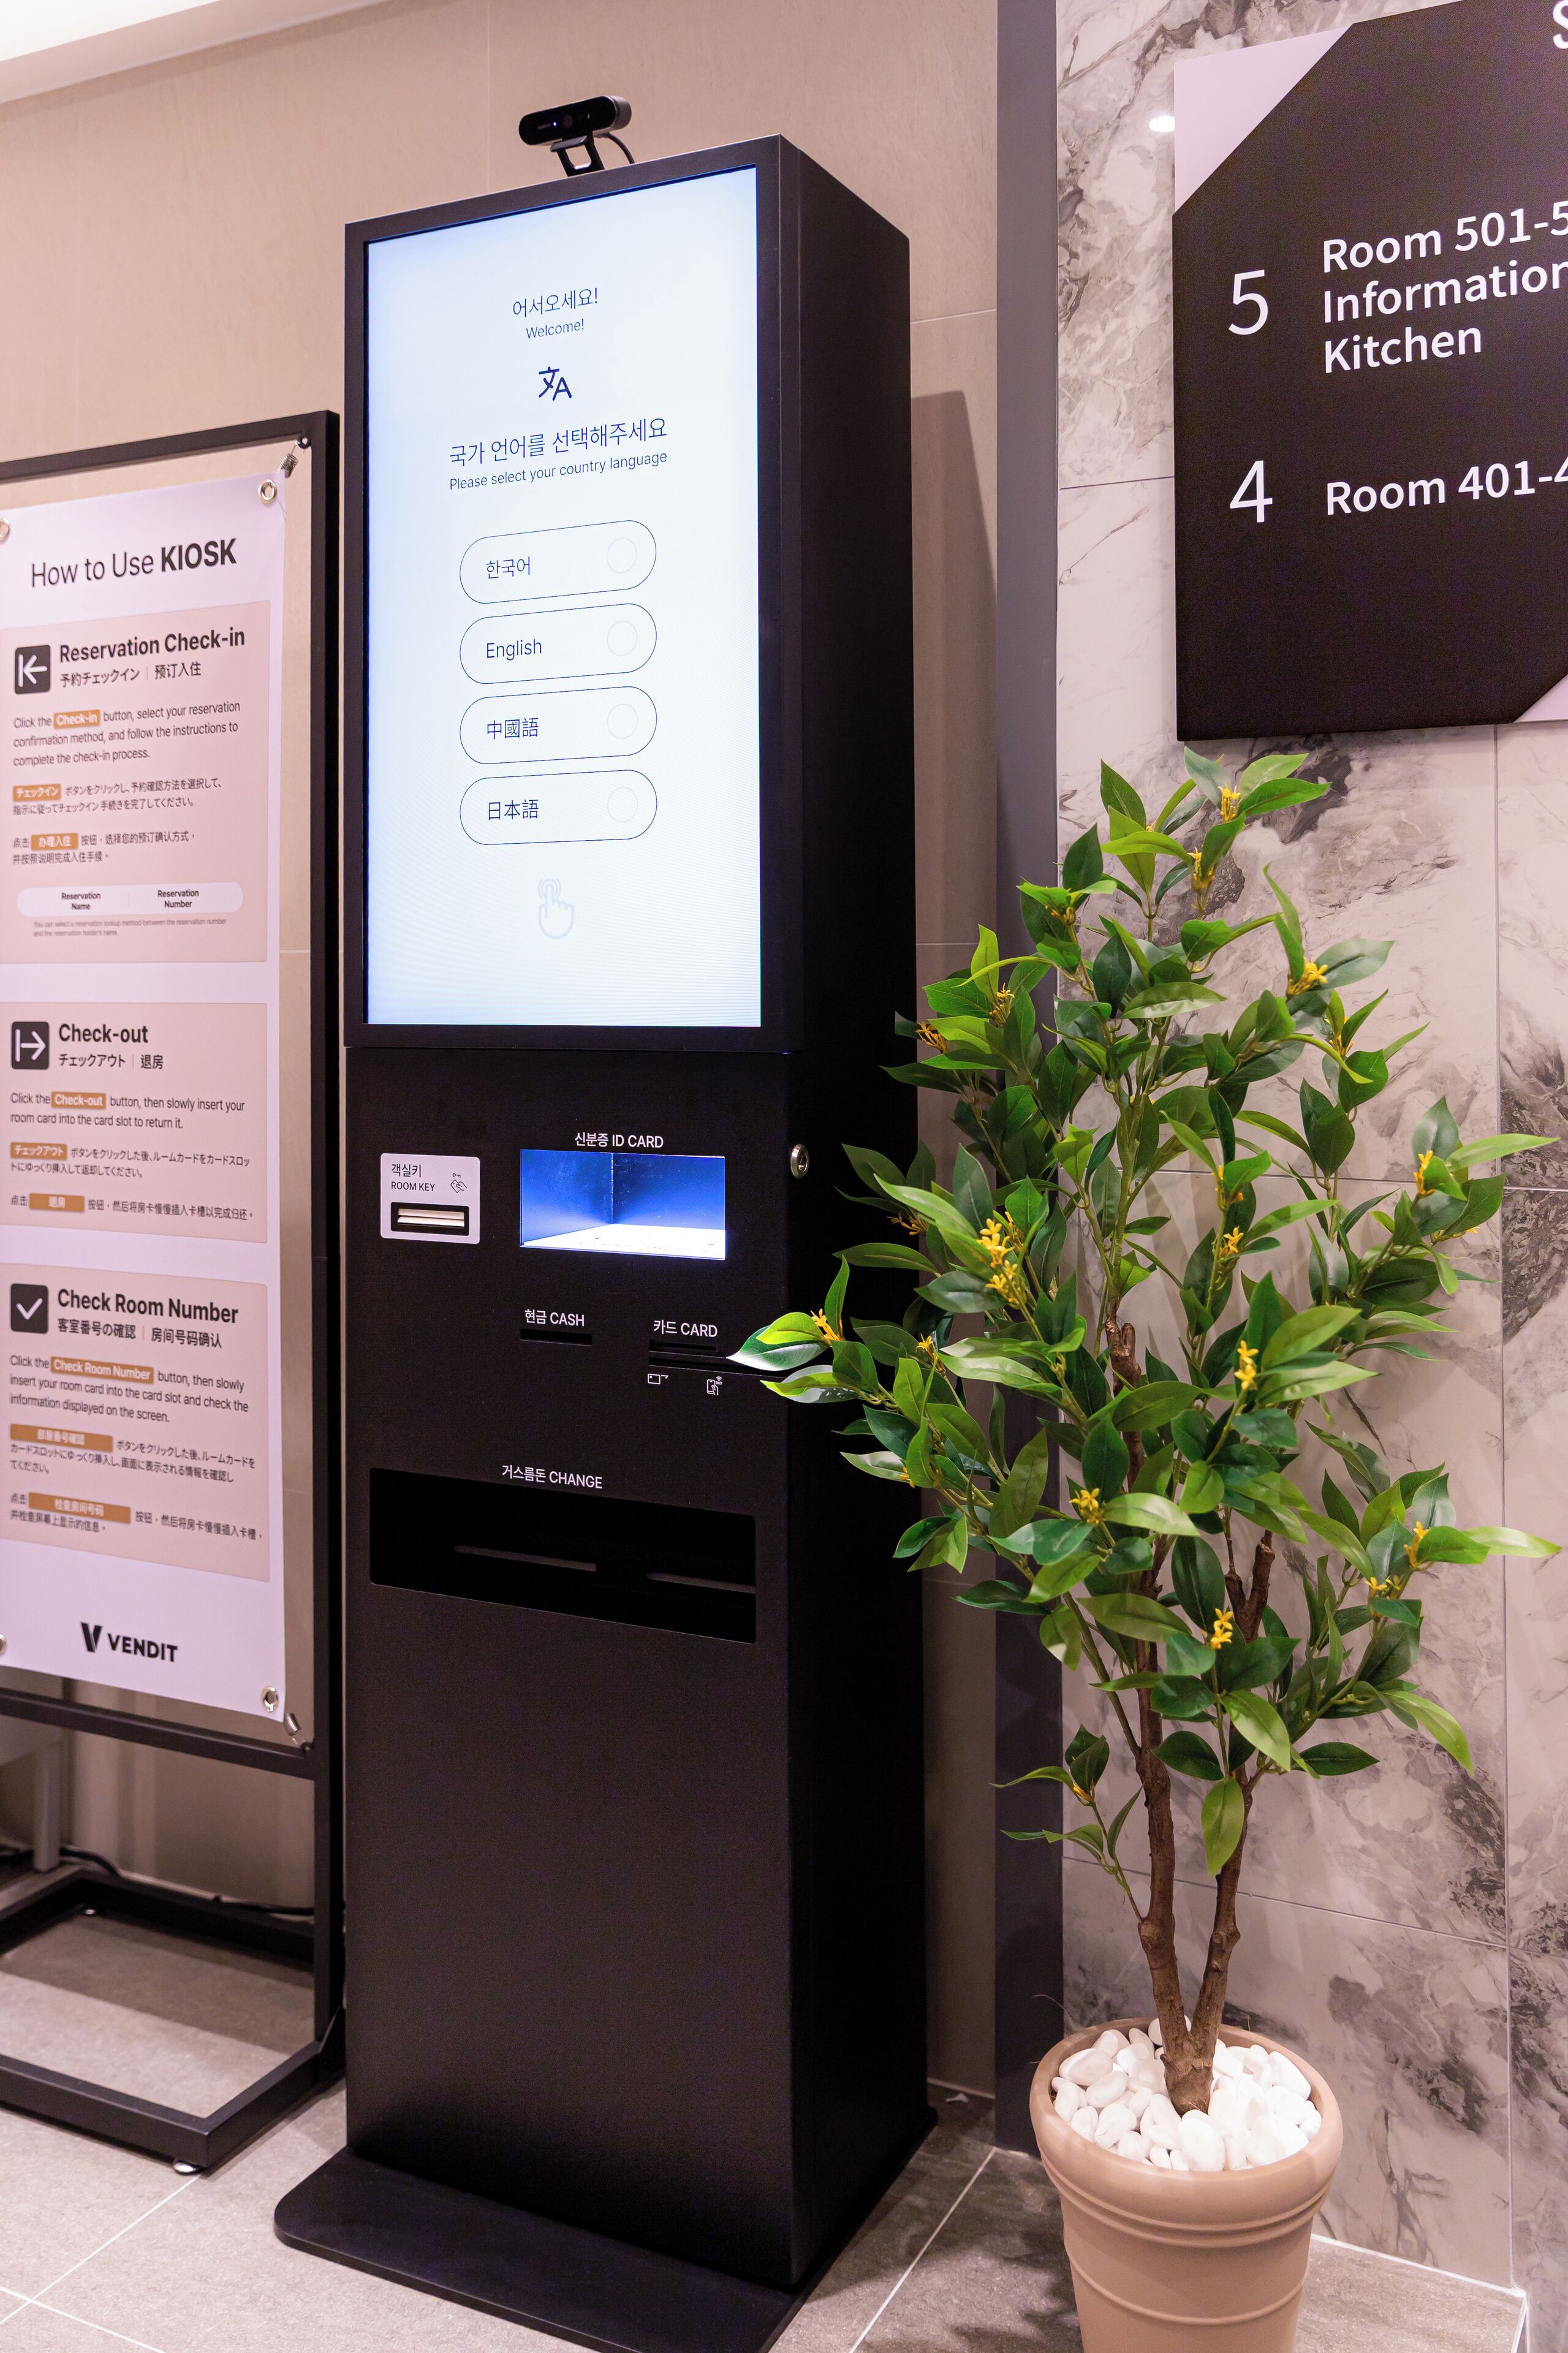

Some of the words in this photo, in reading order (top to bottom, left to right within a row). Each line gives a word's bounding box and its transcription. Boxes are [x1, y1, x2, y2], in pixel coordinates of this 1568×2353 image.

[1324, 227, 1441, 273] Room
[1455, 200, 1568, 251] 501-5
[513, 287, 598, 318] 어서오세요!
[1228, 270, 1269, 335] 5
[1324, 260, 1568, 323] Information
[526, 319, 584, 339] Welcome!
[1325, 325, 1482, 373] Kitchen
[450, 442, 485, 466] 국가
[491, 434, 545, 462] 언어를
[552, 418, 667, 453] 선택해주세요
[450, 474, 487, 490] Please
[491, 469, 526, 486] select
[530, 466, 556, 482] your
[559, 461, 606, 479] country
[610, 451, 667, 472] language
[1230, 460, 1273, 523] 4
[1327, 476, 1445, 515] Room
[31, 562, 78, 588] How
[85, 559, 105, 580] to
[112, 552, 154, 578] Use
[161, 538, 237, 572] KIOSK
[485, 556, 531, 579] 한국어
[60, 636, 159, 662] Reservation
[164, 627, 245, 653] Check-in
[486, 638, 542, 661] English
[61, 668, 140, 688] 予約チェックイン
[154, 661, 201, 680] 预订入住
[14, 717, 35, 729] Click
[37, 718, 51, 727] the
[56, 712, 97, 726] Check-in
[104, 711, 134, 722] button,
[137, 708, 164, 719] select
[166, 707, 186, 719] your
[189, 701, 240, 716] reservation
[13, 734, 68, 748] confirmation
[70, 732, 106, 744] method,
[108, 729, 125, 741] and
[127, 728, 153, 740] follow
[156, 727, 171, 737] the
[173, 722, 226, 736] instructions
[229, 722, 238, 732] to
[487, 718, 539, 740] 中國語
[13, 755, 55, 767] complete
[56, 754, 70, 763] the
[73, 751, 110, 763] check-in
[112, 750, 150, 761] process.
[488, 799, 539, 820] 日本語
[157, 889, 199, 898] Reservation
[59, 1023, 148, 1044] Check-out
[59, 1054, 125, 1068] チェックアウト
[140, 1055, 163, 1070] 退房
[10, 1093, 33, 1104] Click
[36, 1093, 50, 1104] the
[54, 1094, 104, 1107] Check-out
[110, 1097, 142, 1109] button,
[144, 1097, 164, 1108] then
[167, 1098, 195, 1112] slowly
[197, 1099, 222, 1110] insert
[225, 1102, 245, 1113] your
[10, 1114, 34, 1123] room
[37, 1113, 57, 1124] card
[59, 1114, 75, 1124] into
[78, 1115, 92, 1125] the
[93, 1115, 113, 1126] card
[115, 1116, 132, 1126] slot
[134, 1117, 143, 1127] to
[145, 1118, 172, 1128] return
[575, 1132, 608, 1147] 신분증
[612, 1134, 624, 1147] ID
[627, 1135, 664, 1148] CARD
[391, 1164, 421, 1178] 객실키
[391, 1181, 417, 1190] ROOM
[419, 1183, 435, 1191] KEY
[58, 1289, 111, 1312] Check
[116, 1294, 164, 1316] Room
[169, 1298, 238, 1324] Number
[525, 1309, 547, 1325] 현금
[550, 1312, 585, 1327] CASH
[58, 1318, 136, 1339] 客室番号の確認
[151, 1328, 222, 1348] 房间号码确认
[653, 1319, 677, 1335] 카드
[681, 1322, 718, 1338] CARD
[10, 1355, 32, 1367] Click
[35, 1357, 50, 1368] the
[53, 1359, 82, 1373] Check
[85, 1363, 110, 1376] Room
[113, 1365, 151, 1380] Number
[157, 1371, 190, 1387] button,
[193, 1374, 213, 1387] then
[216, 1377, 244, 1393] slowly
[10, 1374, 36, 1387] insert
[38, 1379, 58, 1390] your
[59, 1382, 82, 1392] room
[85, 1383, 104, 1394] card
[107, 1385, 123, 1396] into
[126, 1387, 140, 1398] the
[142, 1389, 162, 1401] card
[165, 1392, 181, 1404] slot
[184, 1395, 201, 1406] and
[203, 1397, 231, 1410] check
[233, 1400, 249, 1412] the
[10, 1392, 60, 1409] information
[63, 1399, 104, 1415] displayed
[107, 1407, 117, 1415] on
[120, 1406, 134, 1417] the
[137, 1411, 170, 1422] screen.
[502, 1464, 546, 1483] 거스름돈
[550, 1471, 602, 1489] CHANGE
[108, 1633, 178, 1662] VENDIT
